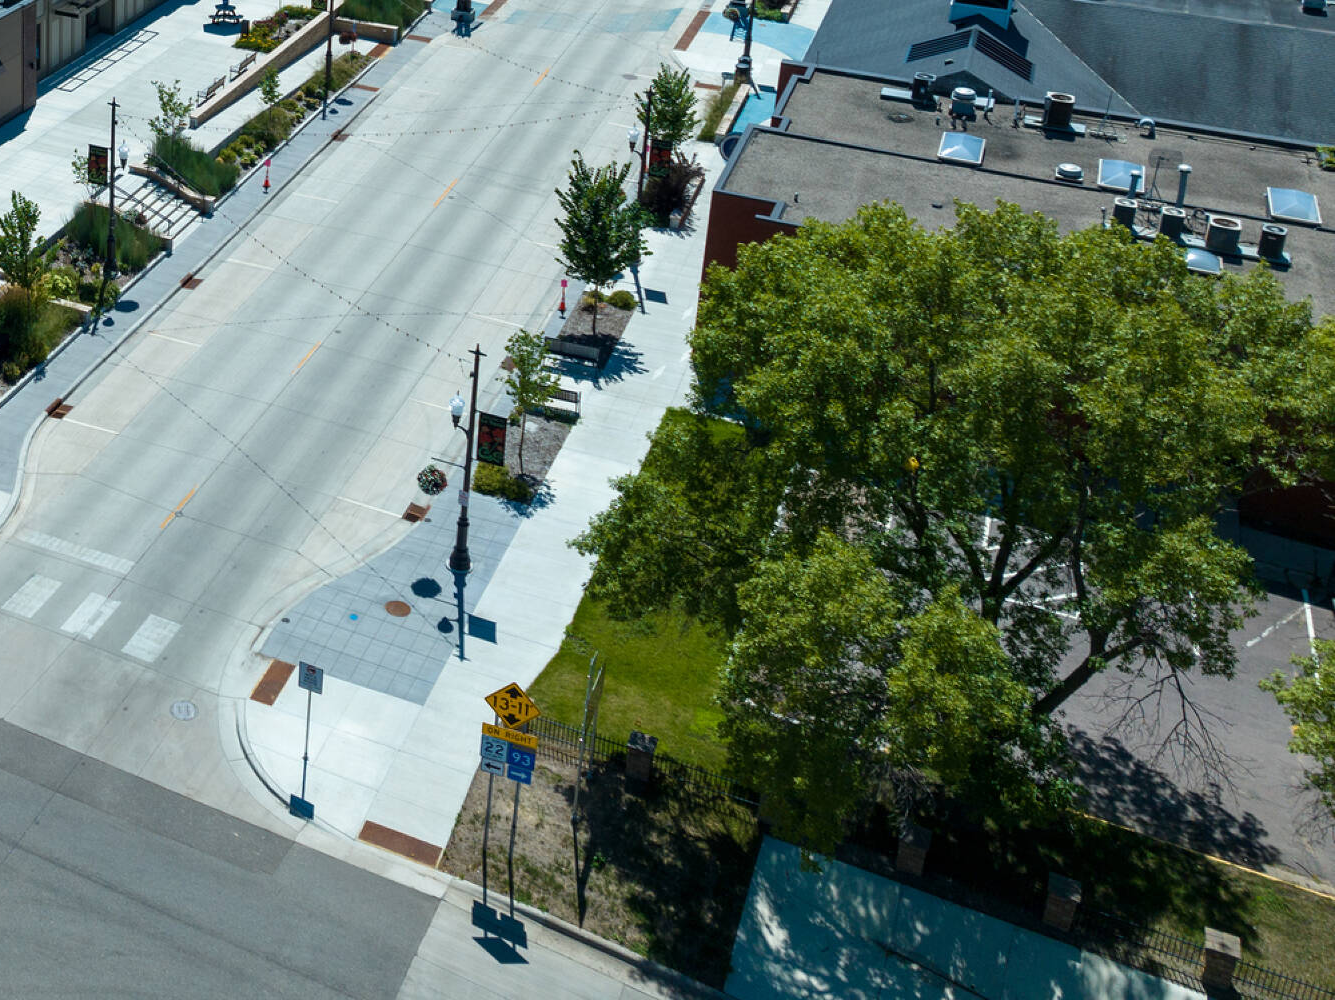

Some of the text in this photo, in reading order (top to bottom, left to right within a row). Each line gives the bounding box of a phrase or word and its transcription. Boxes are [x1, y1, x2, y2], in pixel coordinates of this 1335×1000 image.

[487, 727, 532, 745] ON RIGHT
[485, 742, 504, 757] 22
[512, 752, 531, 767] 93
